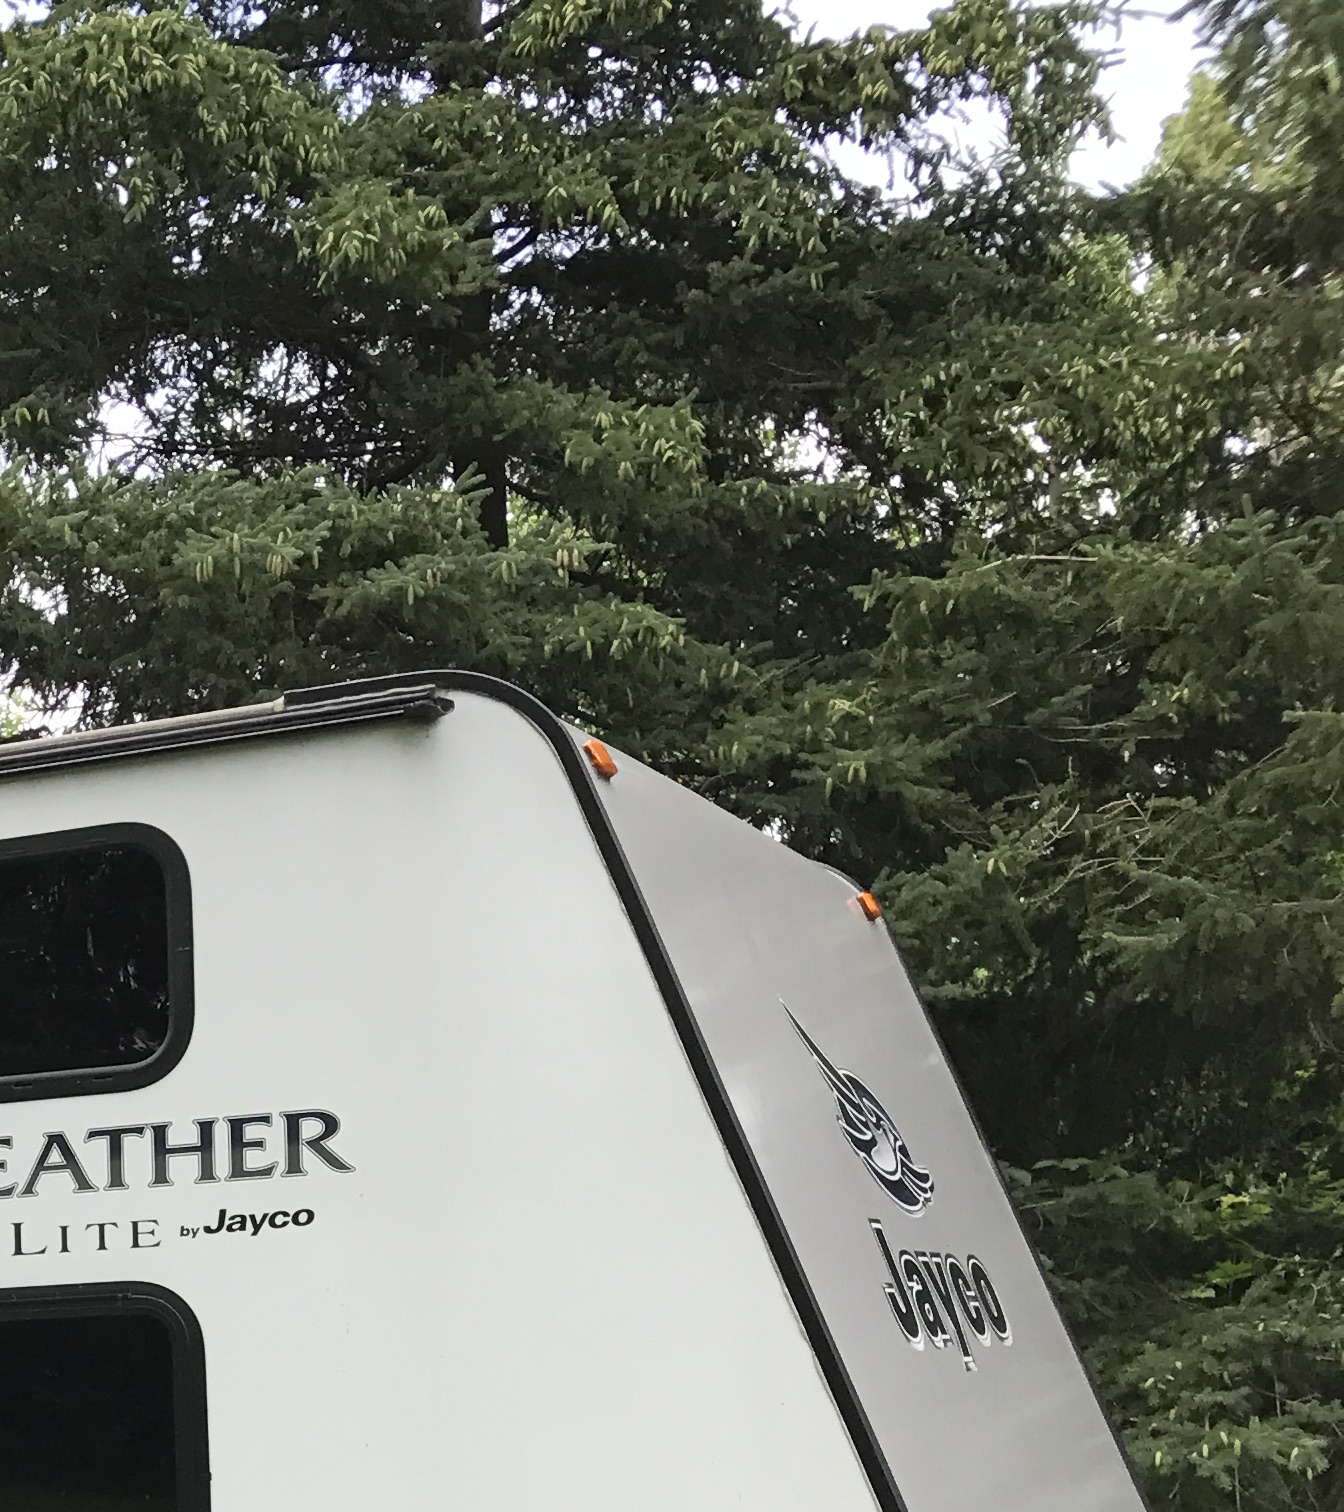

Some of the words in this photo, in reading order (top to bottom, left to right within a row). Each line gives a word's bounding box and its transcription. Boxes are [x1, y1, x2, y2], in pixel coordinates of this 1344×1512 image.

[10, 1218, 163, 1257] LITE
[179, 1223, 200, 1239] by
[202, 1203, 316, 1237] Jayco
[867, 1217, 1014, 1373] Jayco
